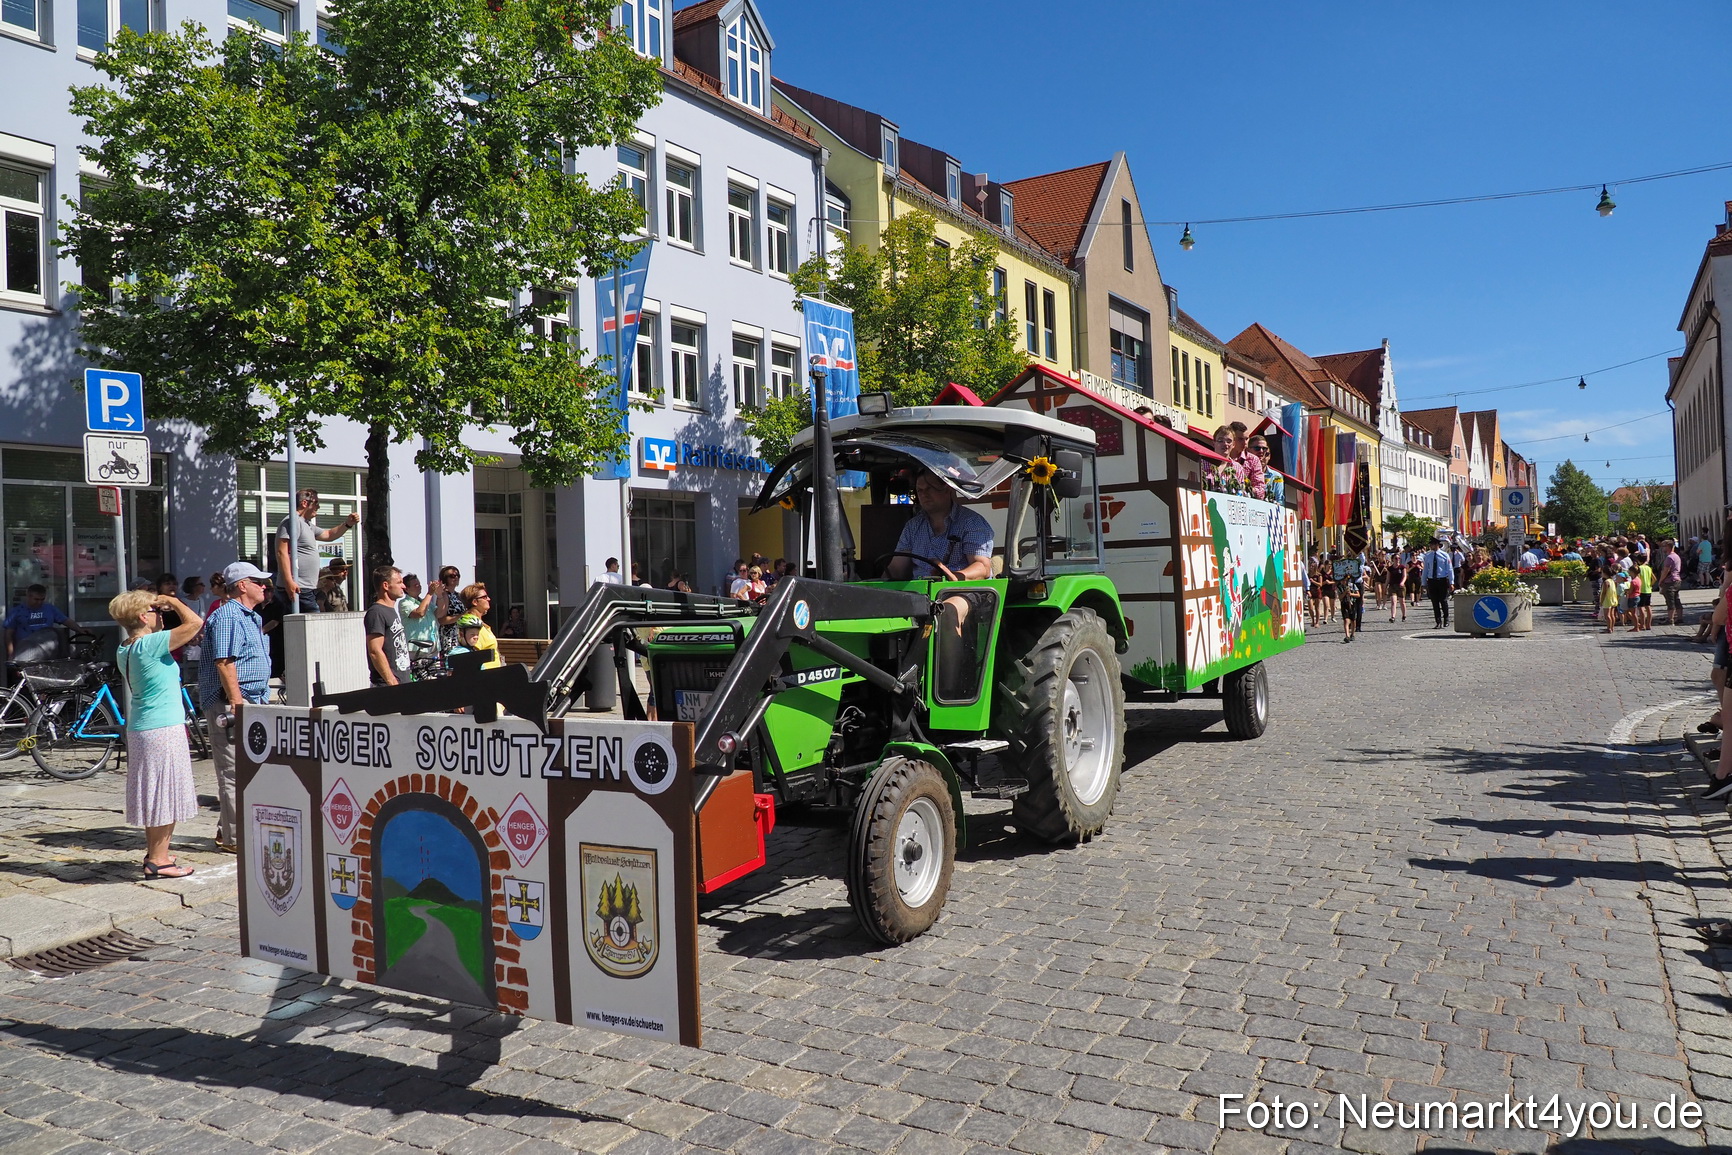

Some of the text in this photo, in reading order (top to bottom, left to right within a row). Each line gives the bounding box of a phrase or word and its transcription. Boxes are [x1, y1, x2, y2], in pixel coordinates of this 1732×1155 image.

[100, 378, 130, 423] P
[108, 440, 127, 450] nur
[658, 634, 735, 642] DEUTZ-FAH
[797, 667, 837, 684] D 4507
[685, 693, 701, 707] NM
[275, 715, 623, 781] HENGER SCHÜTZEN
[331, 804, 352, 812] HENGER
[336, 814, 347, 825] SV
[499, 825, 506, 833] 19
[508, 822, 535, 831] HENGER
[537, 828, 546, 836] 63
[515, 833, 529, 845] SV
